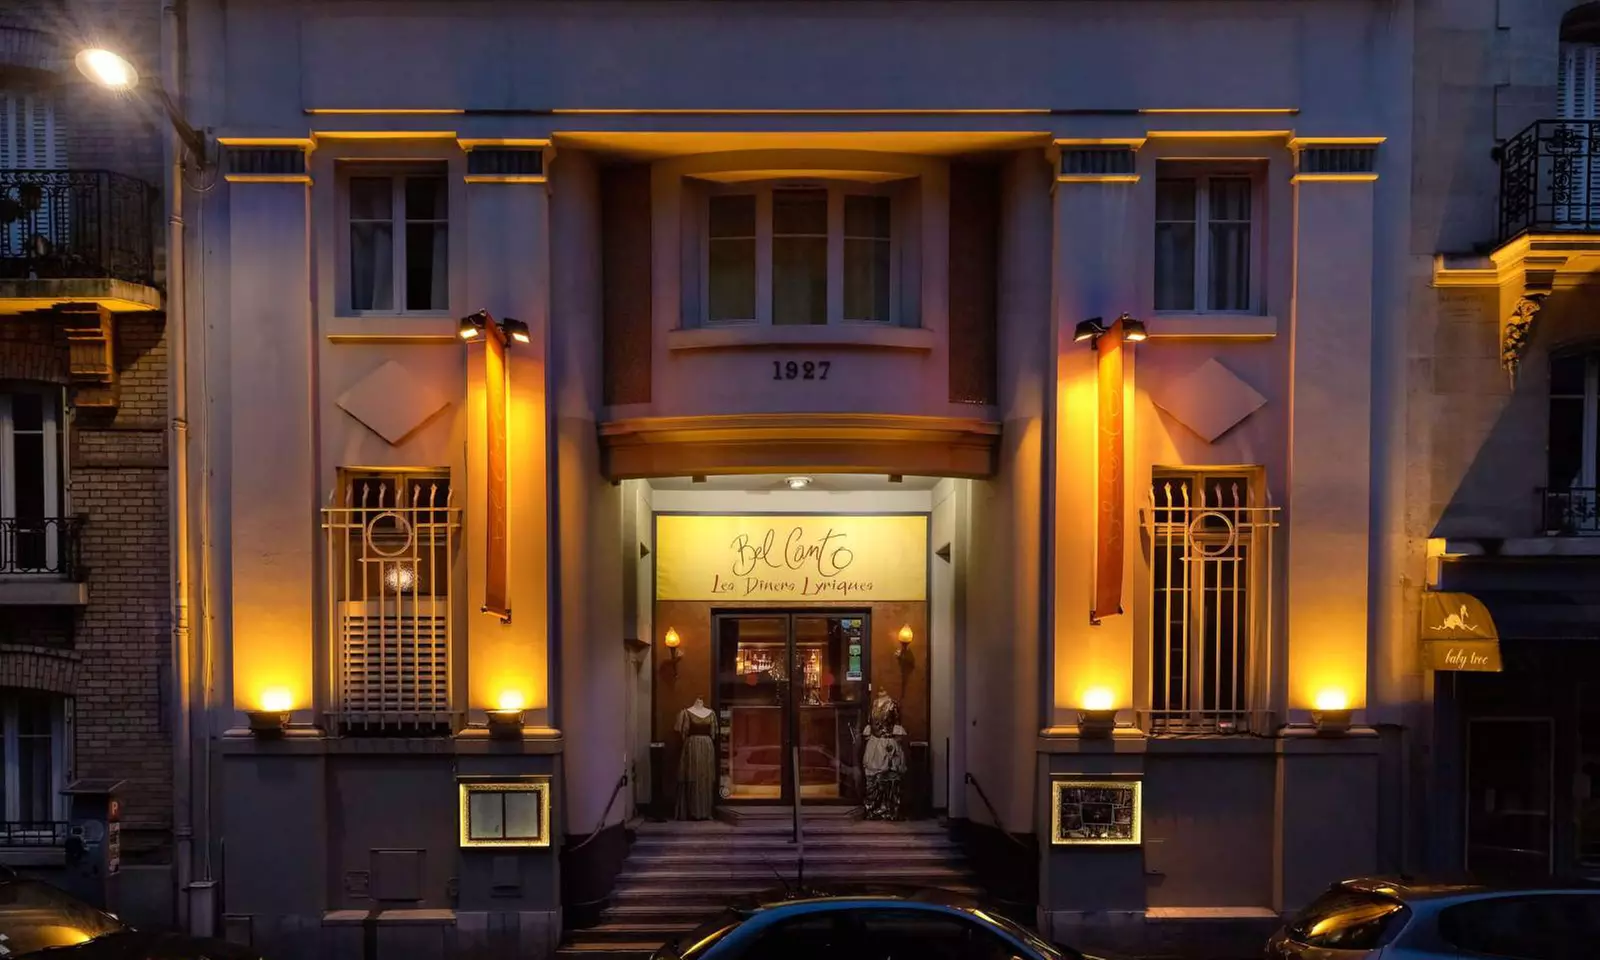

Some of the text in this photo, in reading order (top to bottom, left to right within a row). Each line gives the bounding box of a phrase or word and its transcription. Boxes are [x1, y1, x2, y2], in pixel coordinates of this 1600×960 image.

[772, 361, 831, 380] 1927
[730, 526, 853, 578] Bel Canto
[711, 574, 735, 593] Les
[801, 576, 874, 596] Lyriques
[1445, 648, 1467, 670] baby
